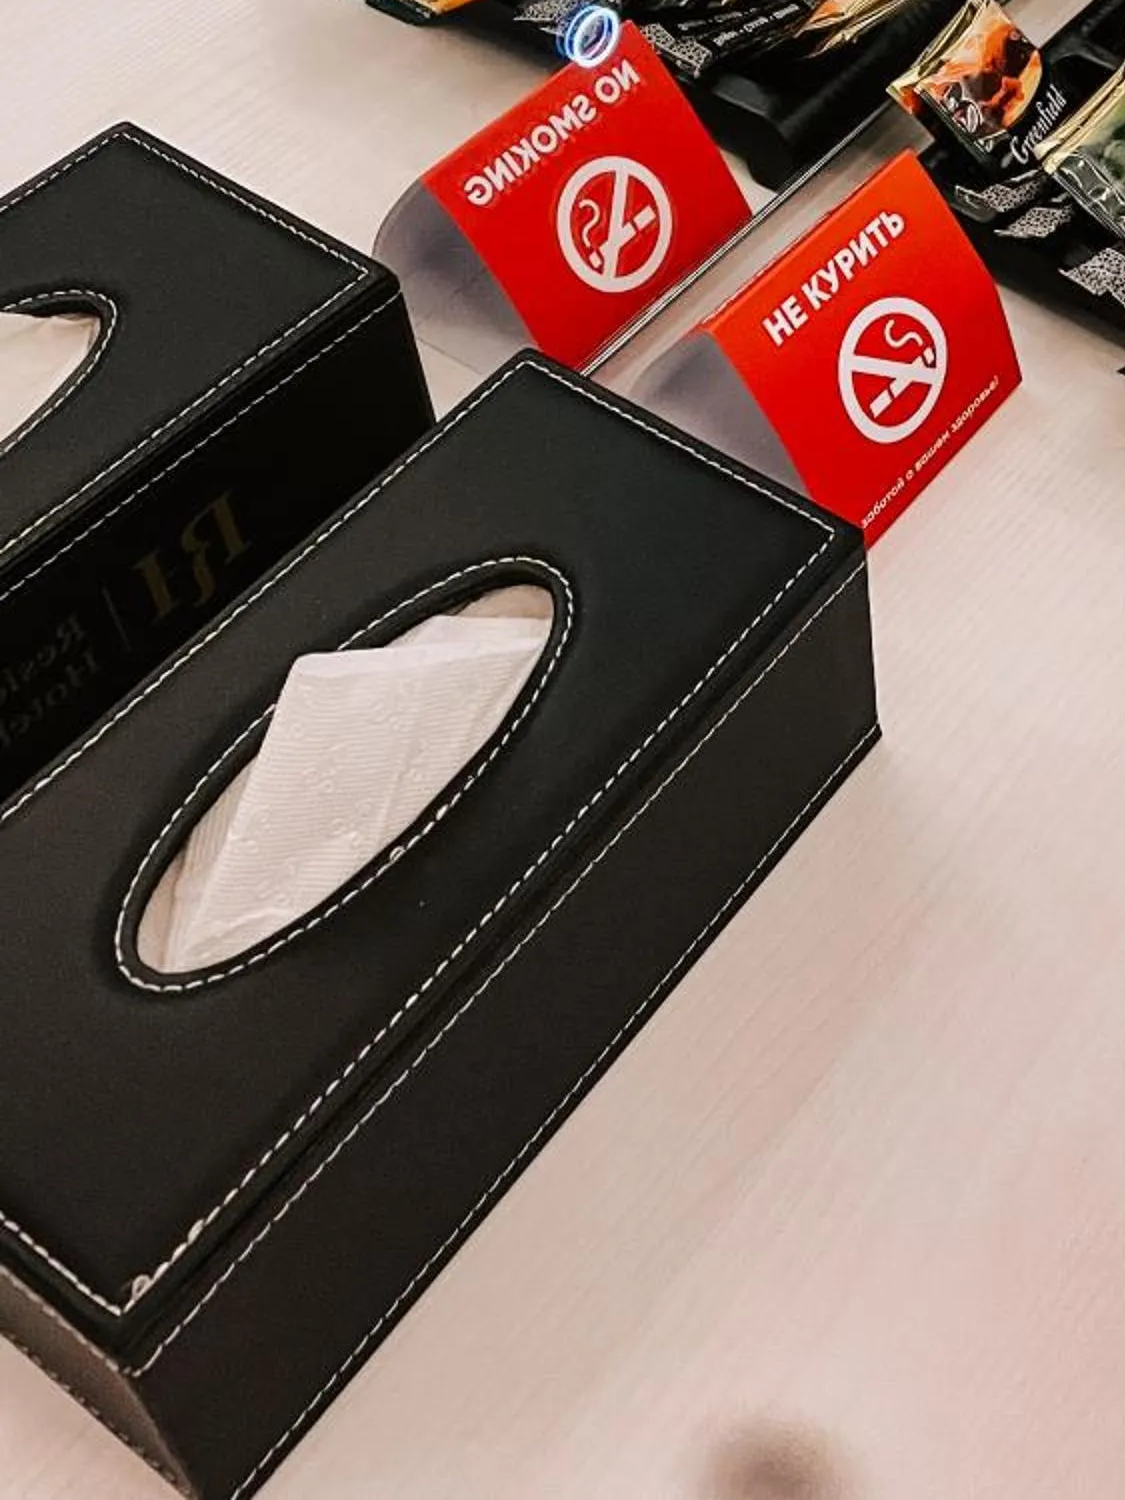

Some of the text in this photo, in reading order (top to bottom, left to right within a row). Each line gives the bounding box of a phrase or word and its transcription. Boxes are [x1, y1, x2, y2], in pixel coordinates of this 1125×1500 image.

[1010, 83, 1068, 165] Greenfield
[762, 211, 905, 347] НЕ КУРИТЬ
